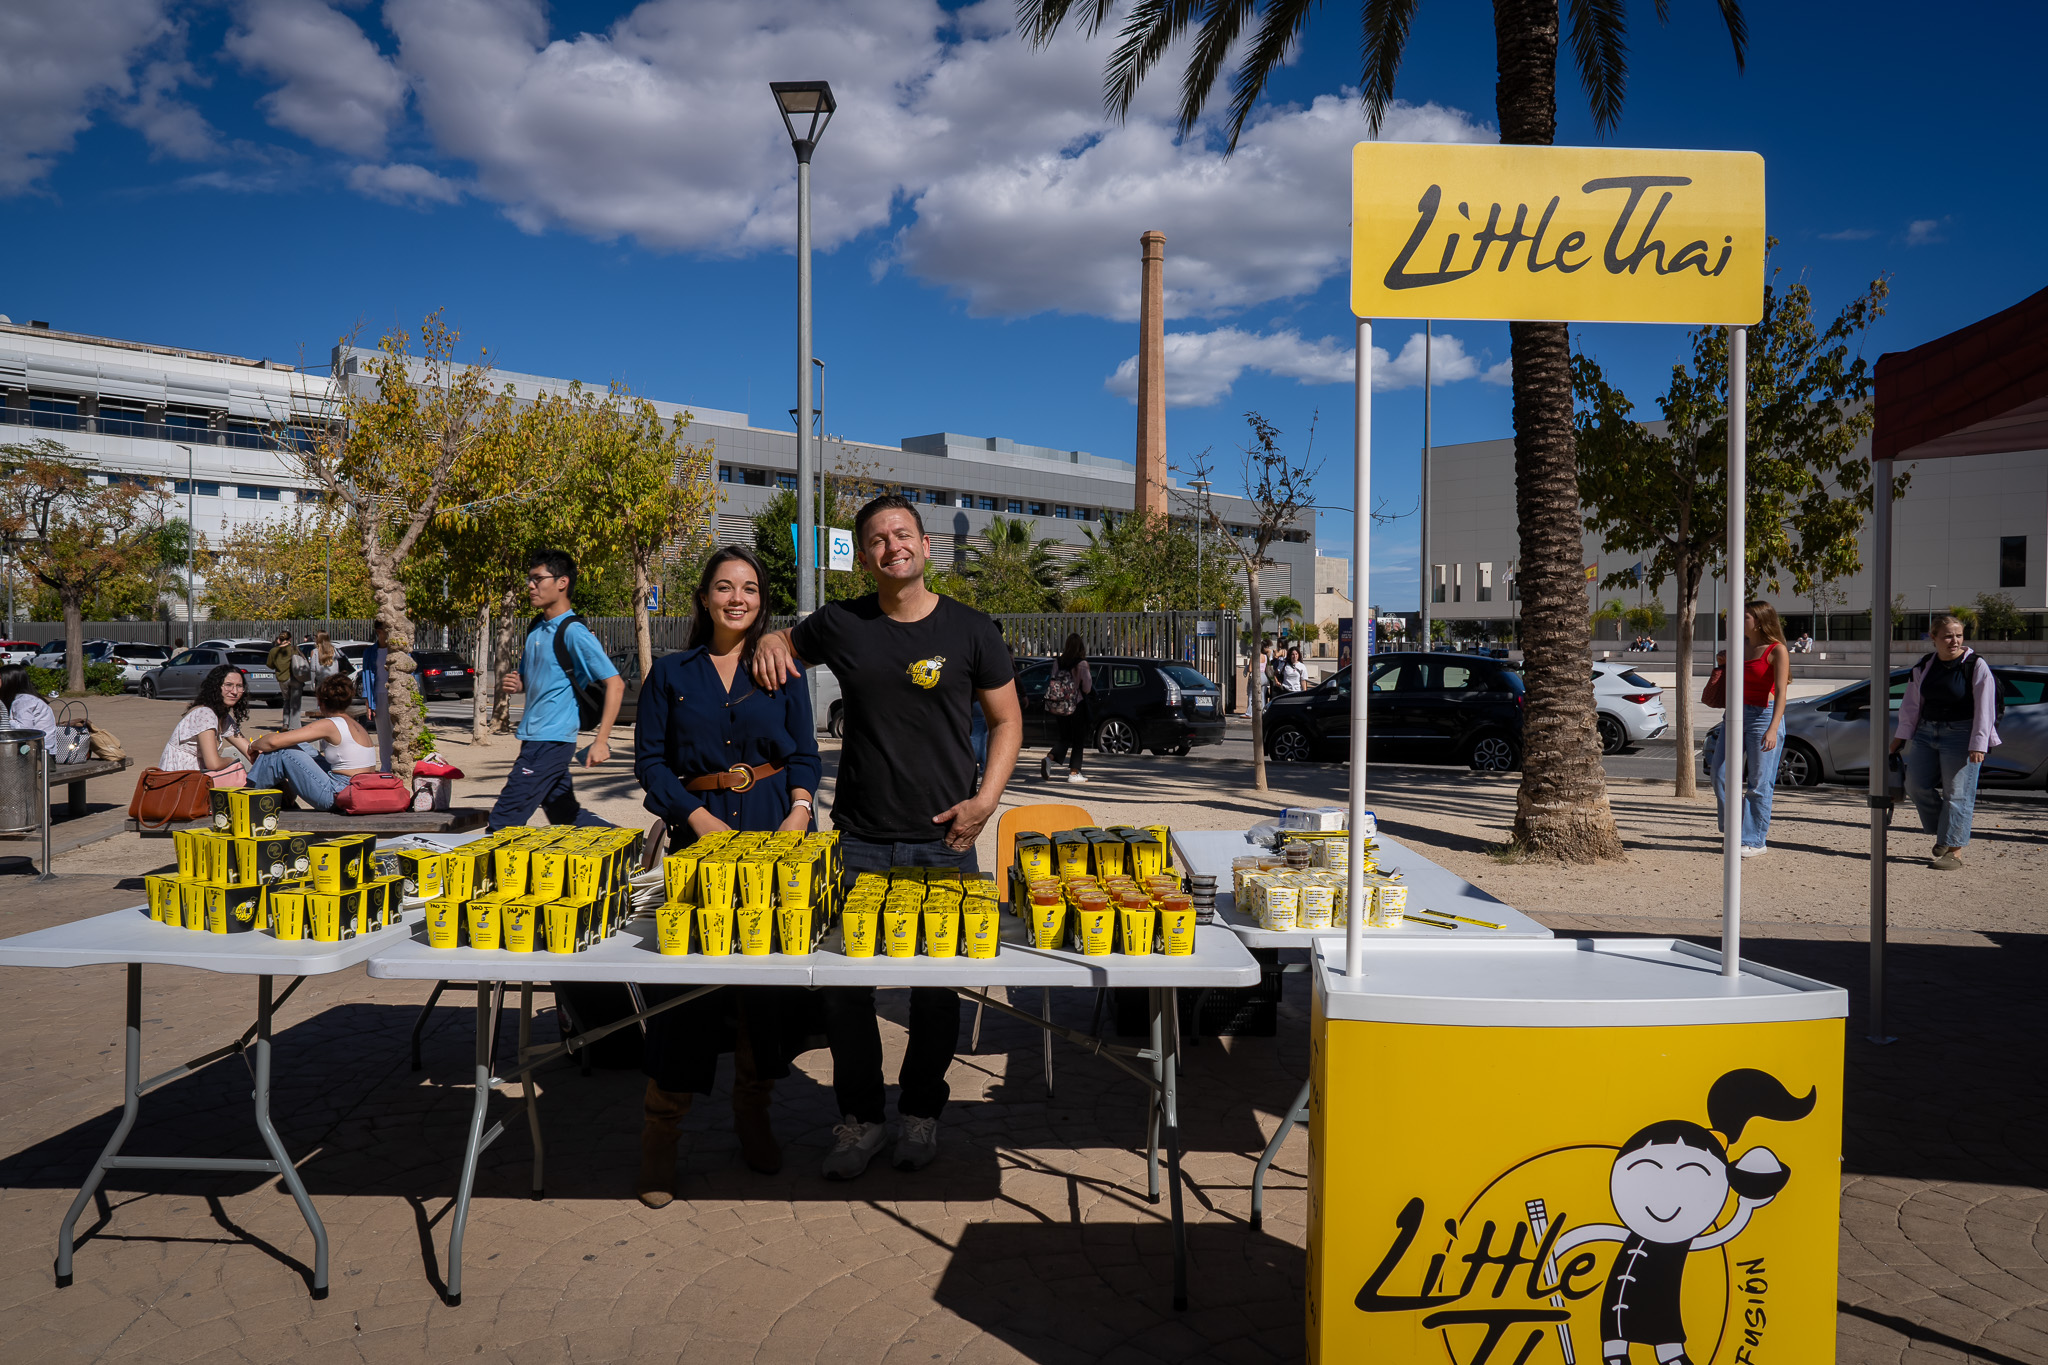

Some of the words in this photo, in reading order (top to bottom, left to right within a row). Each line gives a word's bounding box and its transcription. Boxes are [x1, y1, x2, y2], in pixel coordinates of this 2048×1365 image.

[1383, 184, 1592, 290] Little
[1581, 175, 1733, 277] Thai
[833, 537, 850, 556] 50
[1354, 1197, 1604, 1313] Little
[1735, 1257, 1768, 1365] FUSIÓN
